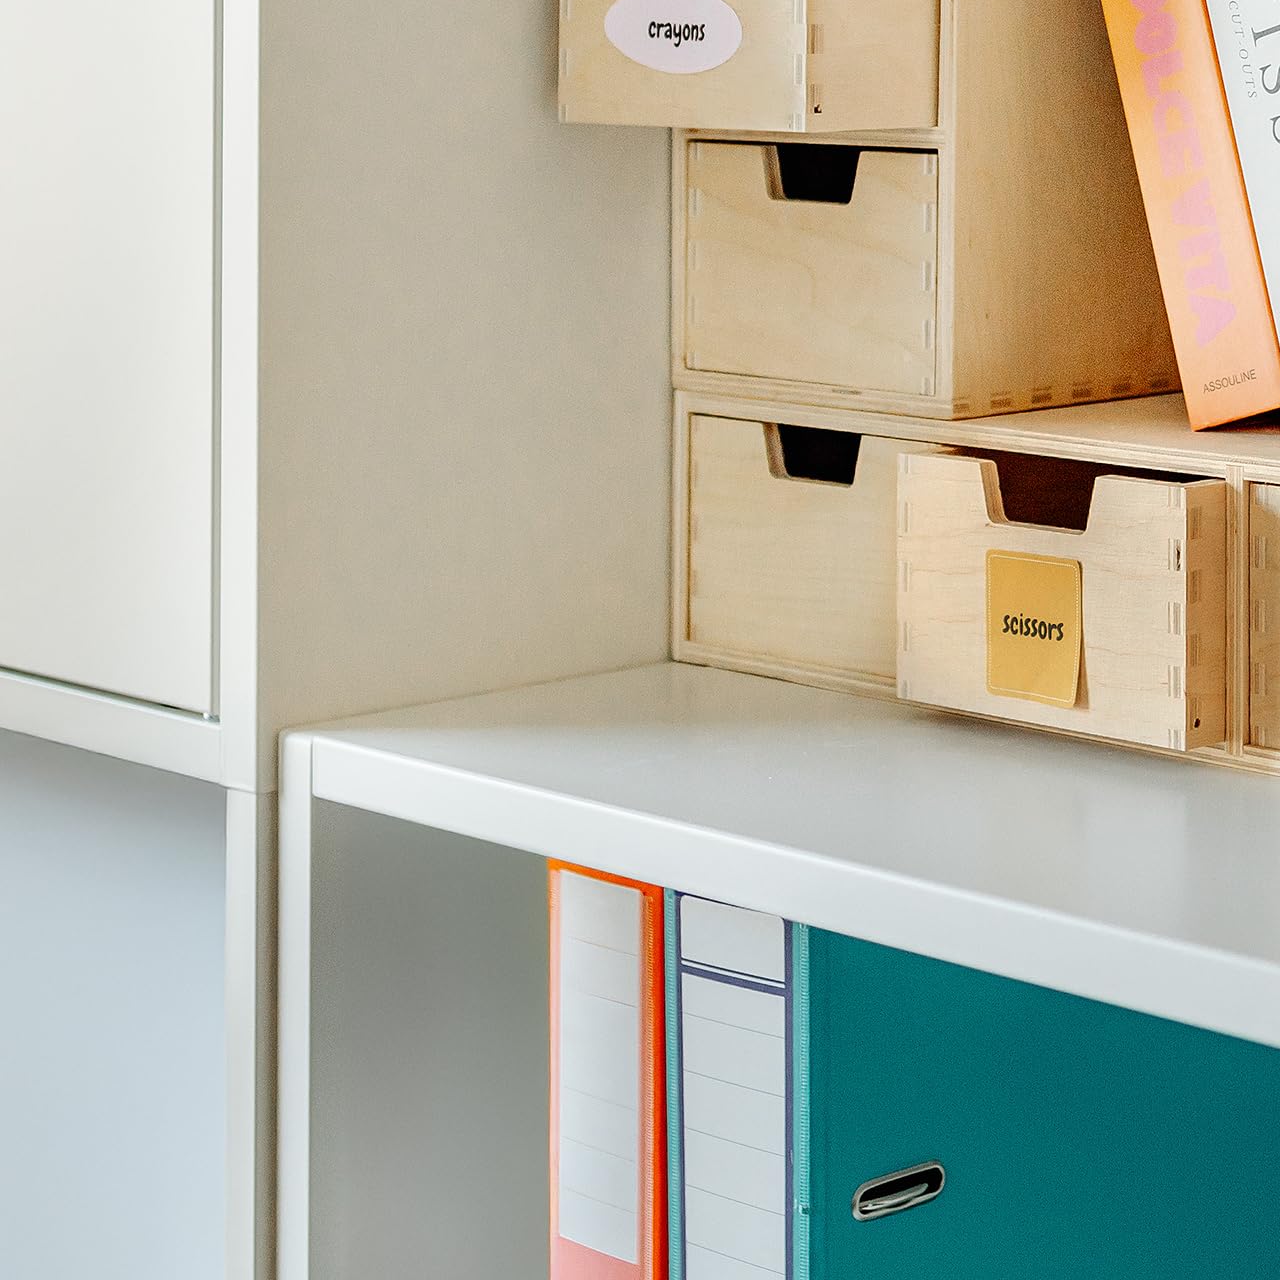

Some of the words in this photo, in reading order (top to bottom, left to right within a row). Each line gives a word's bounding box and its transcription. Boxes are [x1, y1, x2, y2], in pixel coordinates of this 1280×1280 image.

[648, 21, 706, 47] crayons
[1228, 0, 1257, 99] CUT-OUTS
[1171, 177, 1237, 348] VITA
[1202, 369, 1257, 394] ASSOULINE
[1002, 613, 1065, 641] scissors
